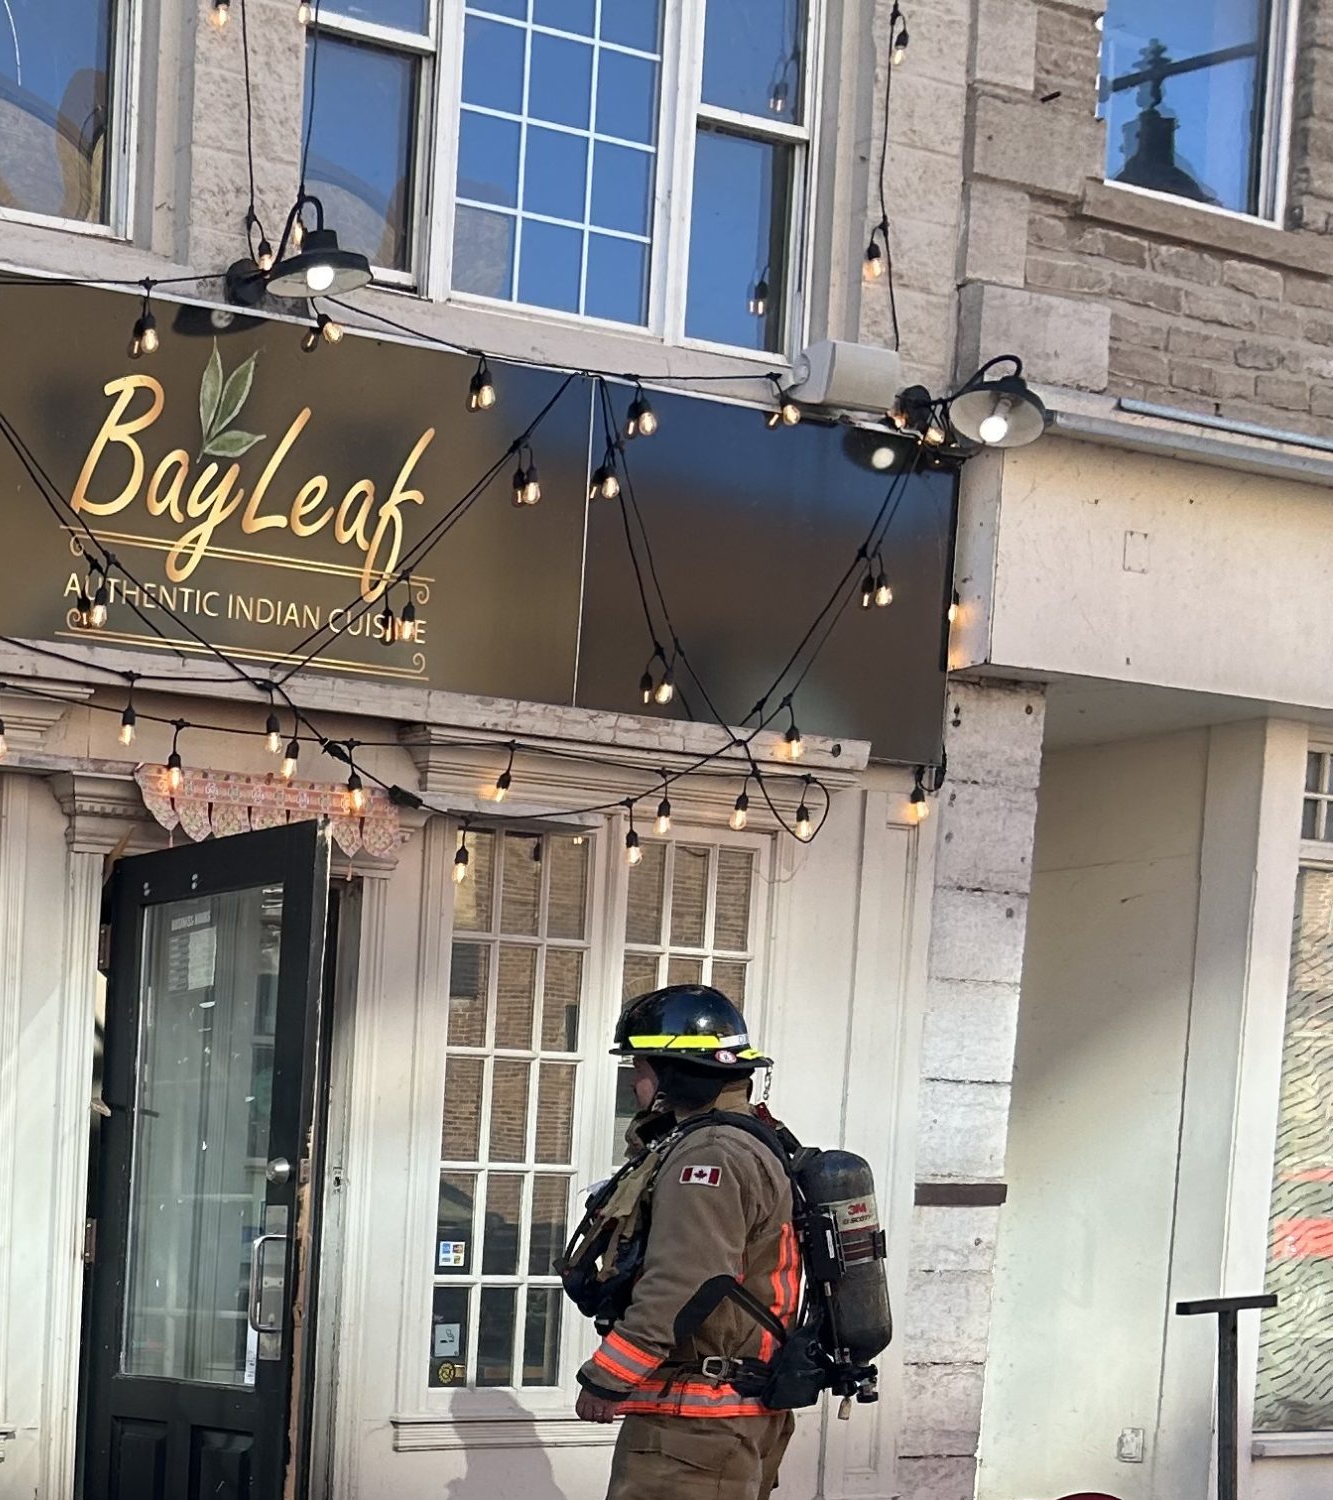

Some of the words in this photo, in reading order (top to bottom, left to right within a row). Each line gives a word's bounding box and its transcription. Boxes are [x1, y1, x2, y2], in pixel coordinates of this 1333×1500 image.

[63, 572, 220, 618] AUTHENTIC
[227, 601, 321, 630] INDIAN
[327, 607, 428, 645] CUISINE
[847, 1203, 867, 1216] 3M
